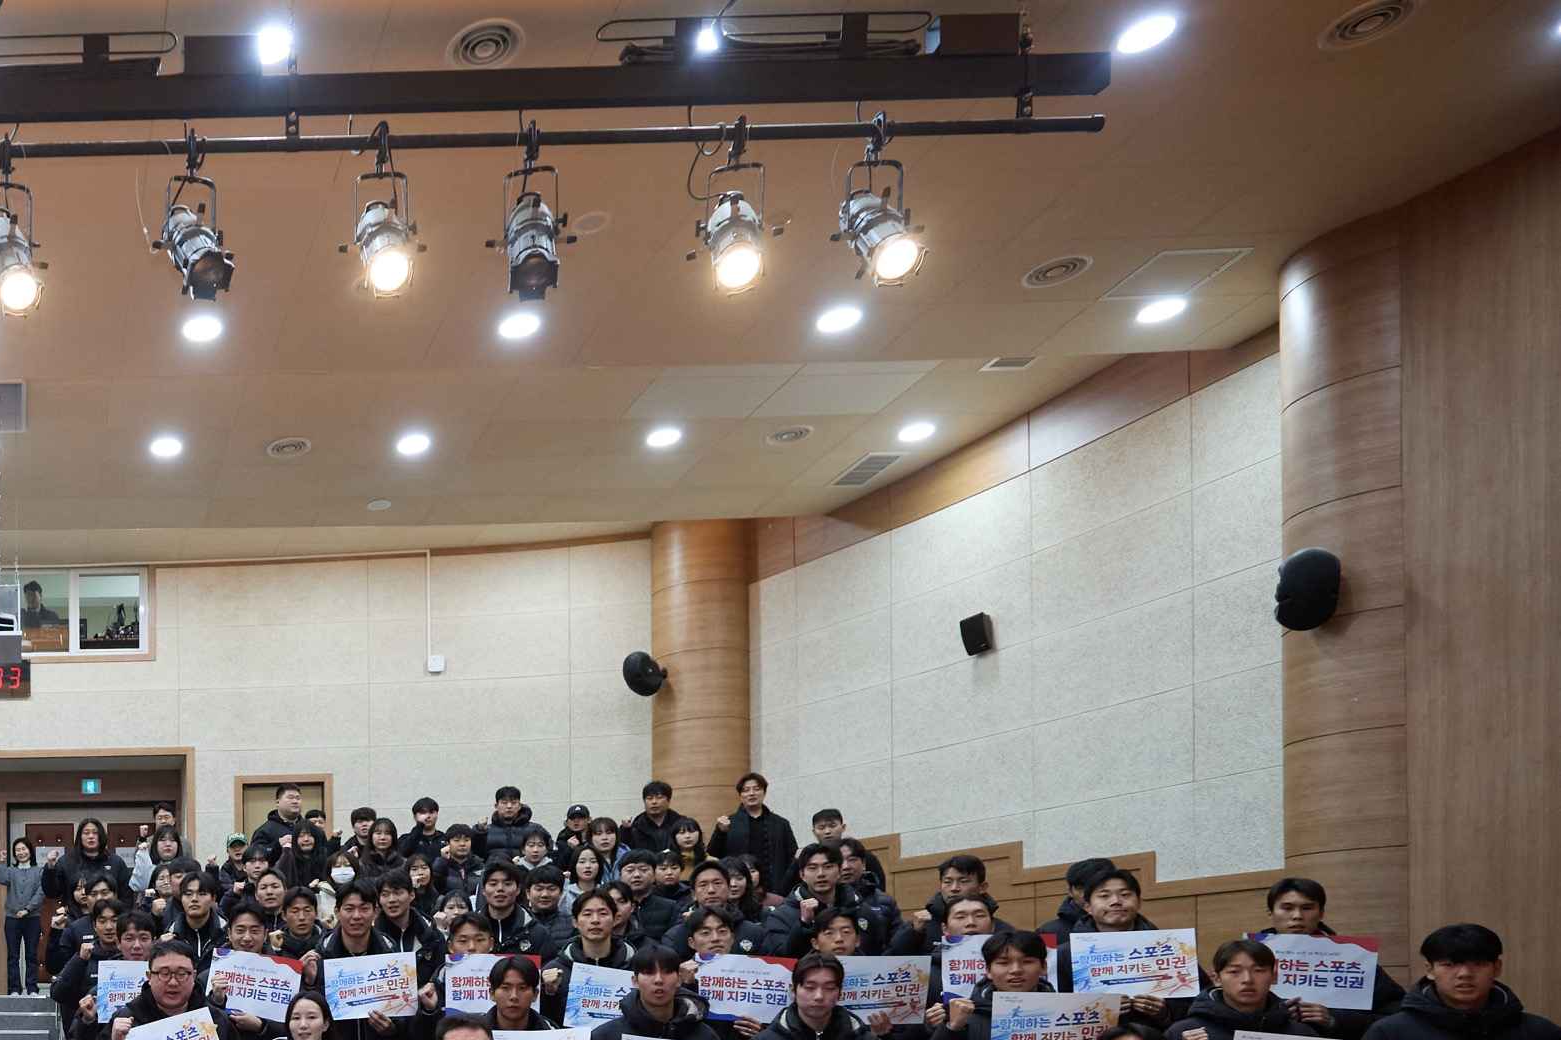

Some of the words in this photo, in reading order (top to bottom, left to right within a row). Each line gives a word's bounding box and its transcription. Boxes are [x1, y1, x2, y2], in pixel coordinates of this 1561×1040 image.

[1128, 945, 1175, 960] 스포츠
[1090, 966, 1114, 977] 함께
[1117, 964, 1152, 974] 지키는
[1155, 956, 1187, 971] 인권
[1278, 959, 1310, 971] 하는
[367, 967, 401, 981] 스포츠
[872, 969, 911, 984] 스포츠
[949, 973, 976, 985] 함께
[338, 988, 357, 1000] 함께
[358, 985, 385, 997] 지키는
[386, 977, 410, 991] 인권
[451, 976, 490, 988] 함께하
[699, 975, 749, 988] 함께하는
[1283, 975, 1328, 987] 지키는
[1333, 975, 1364, 989] 인권
[108, 992, 127, 1002] 함께
[238, 987, 267, 1000] 지키는
[270, 991, 292, 1006] 인권
[451, 989, 478, 1001] 함께
[699, 989, 724, 1001] 함께
[727, 990, 762, 1003] 지키는
[765, 992, 789, 1006] 인권
[859, 988, 892, 999] 지키는
[894, 982, 920, 998] 인권
[580, 997, 600, 1009] 함께
[998, 1017, 1051, 1030] 함께하는
[1055, 1011, 1100, 1026] 스포츠
